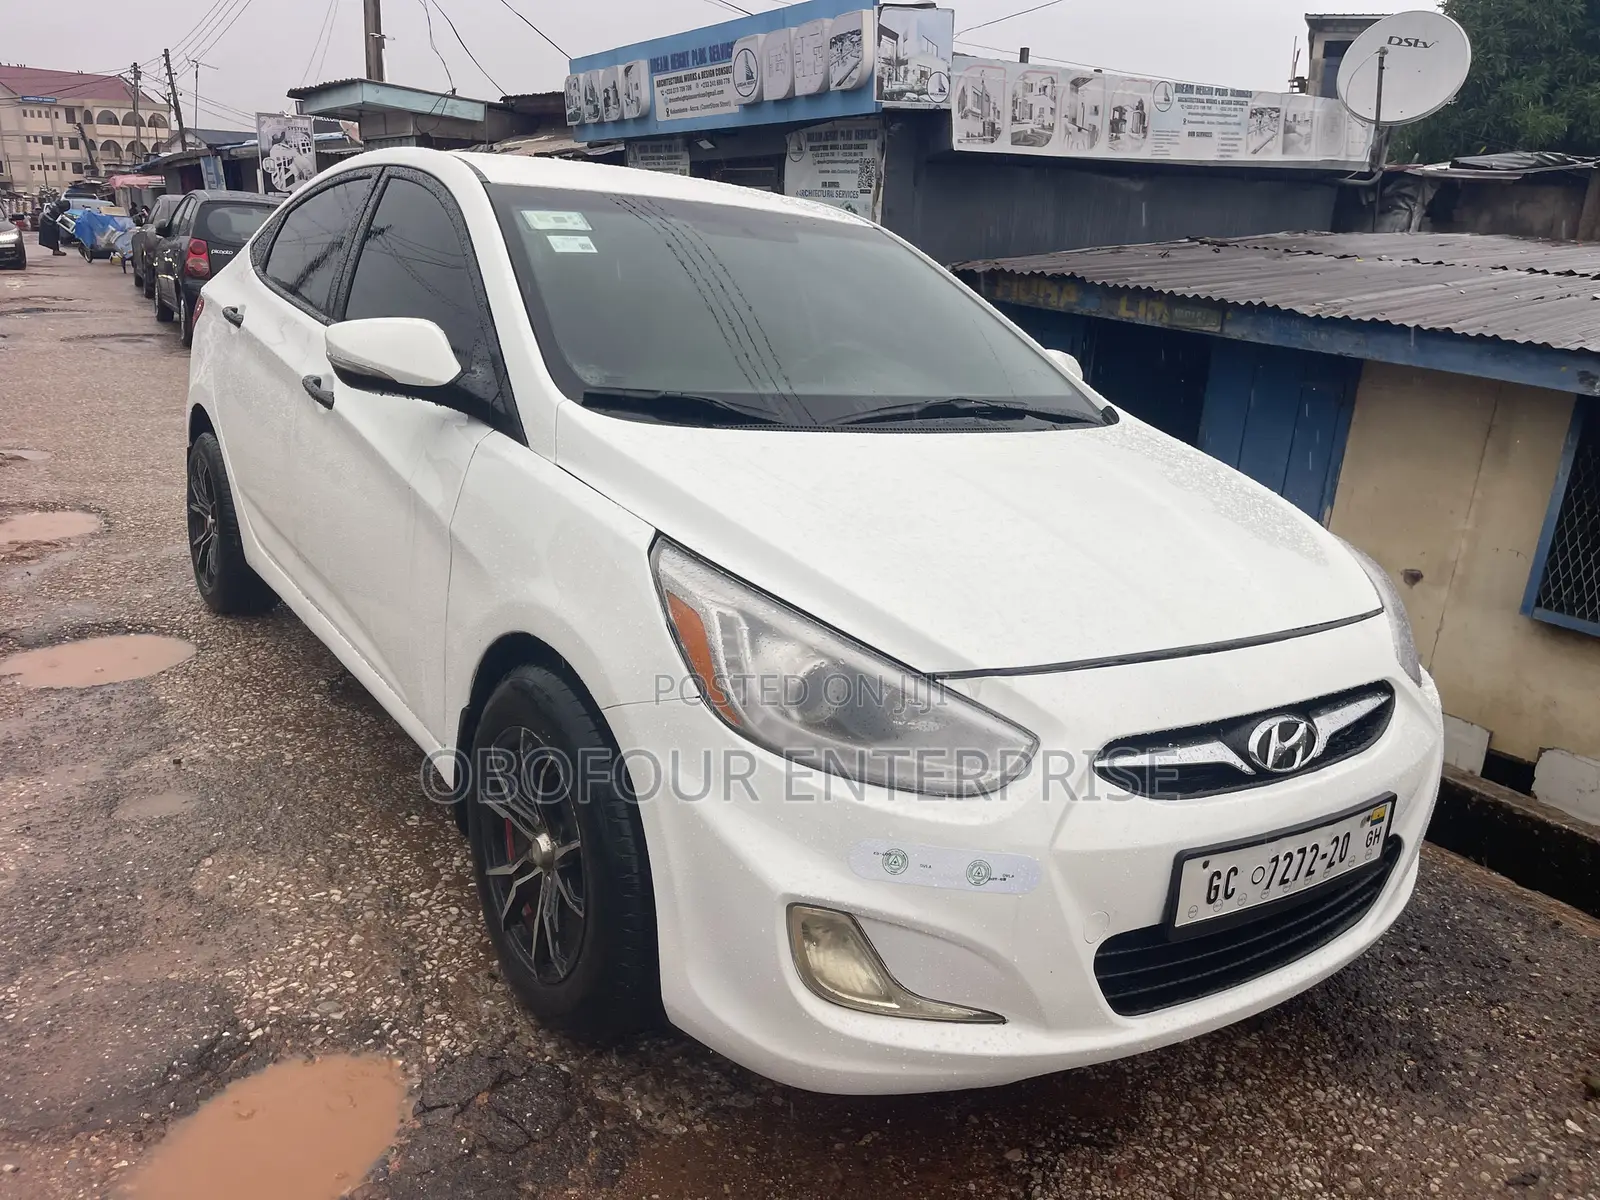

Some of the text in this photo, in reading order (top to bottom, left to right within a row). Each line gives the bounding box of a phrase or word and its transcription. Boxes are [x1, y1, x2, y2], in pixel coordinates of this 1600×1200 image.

[684, 72, 698, 83] WORKS
[701, 69, 715, 79] DESIGN
[835, 190, 859, 199] SERVICES
[1365, 826, 1382, 848] GH
[1206, 831, 1351, 905] GC 7272-20
